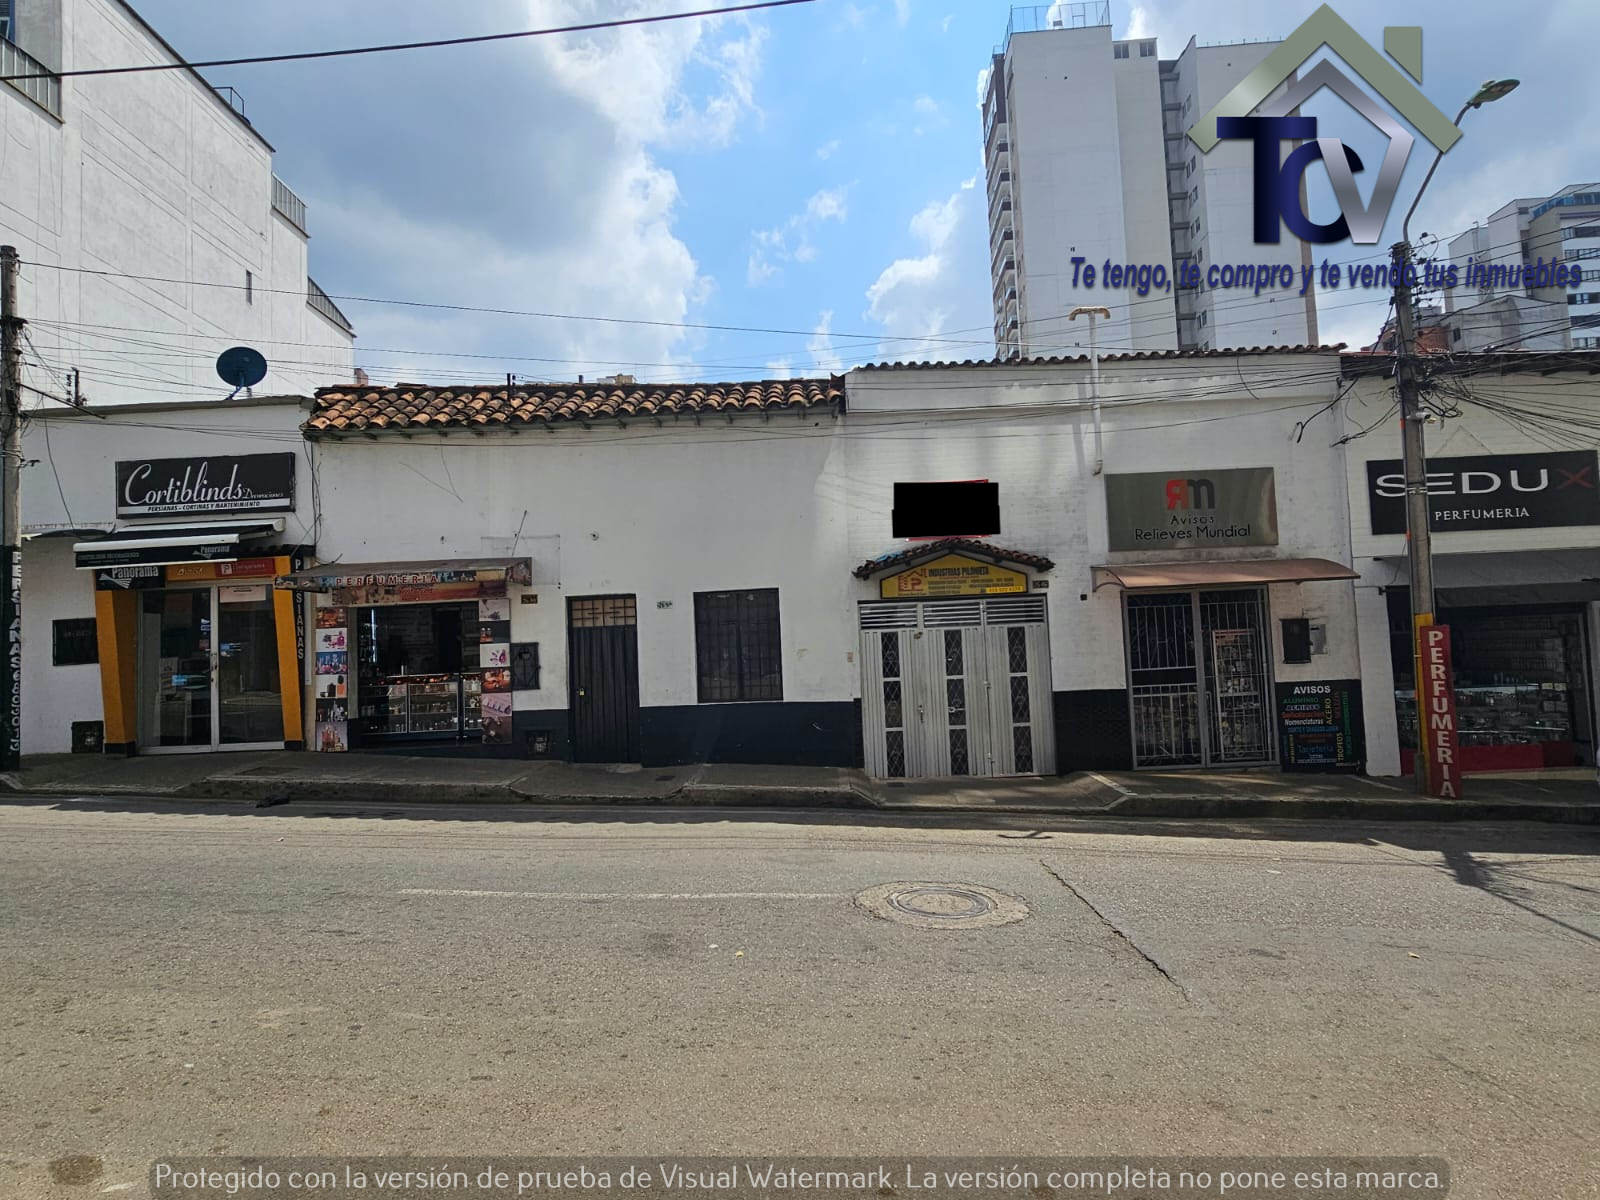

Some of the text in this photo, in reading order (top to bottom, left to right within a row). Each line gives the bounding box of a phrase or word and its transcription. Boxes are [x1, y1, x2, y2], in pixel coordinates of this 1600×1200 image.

[125, 461, 242, 505] Cortiblinds
[1375, 464, 1595, 498] SEDUX
[182, 503, 210, 511] CORTINAS
[1434, 507, 1530, 521] PERFUMERIA
[1170, 515, 1214, 526] Avisos
[1135, 524, 1251, 541] Relieves Mundial
[111, 566, 160, 579] Panorama
[335, 574, 439, 586] PERFUMERIA
[9, 551, 22, 669] PERSIANAS
[296, 559, 305, 660] PSIANAS
[1294, 686, 1330, 694] AVISOS
[1428, 630, 1456, 798] PERFUMERIA
